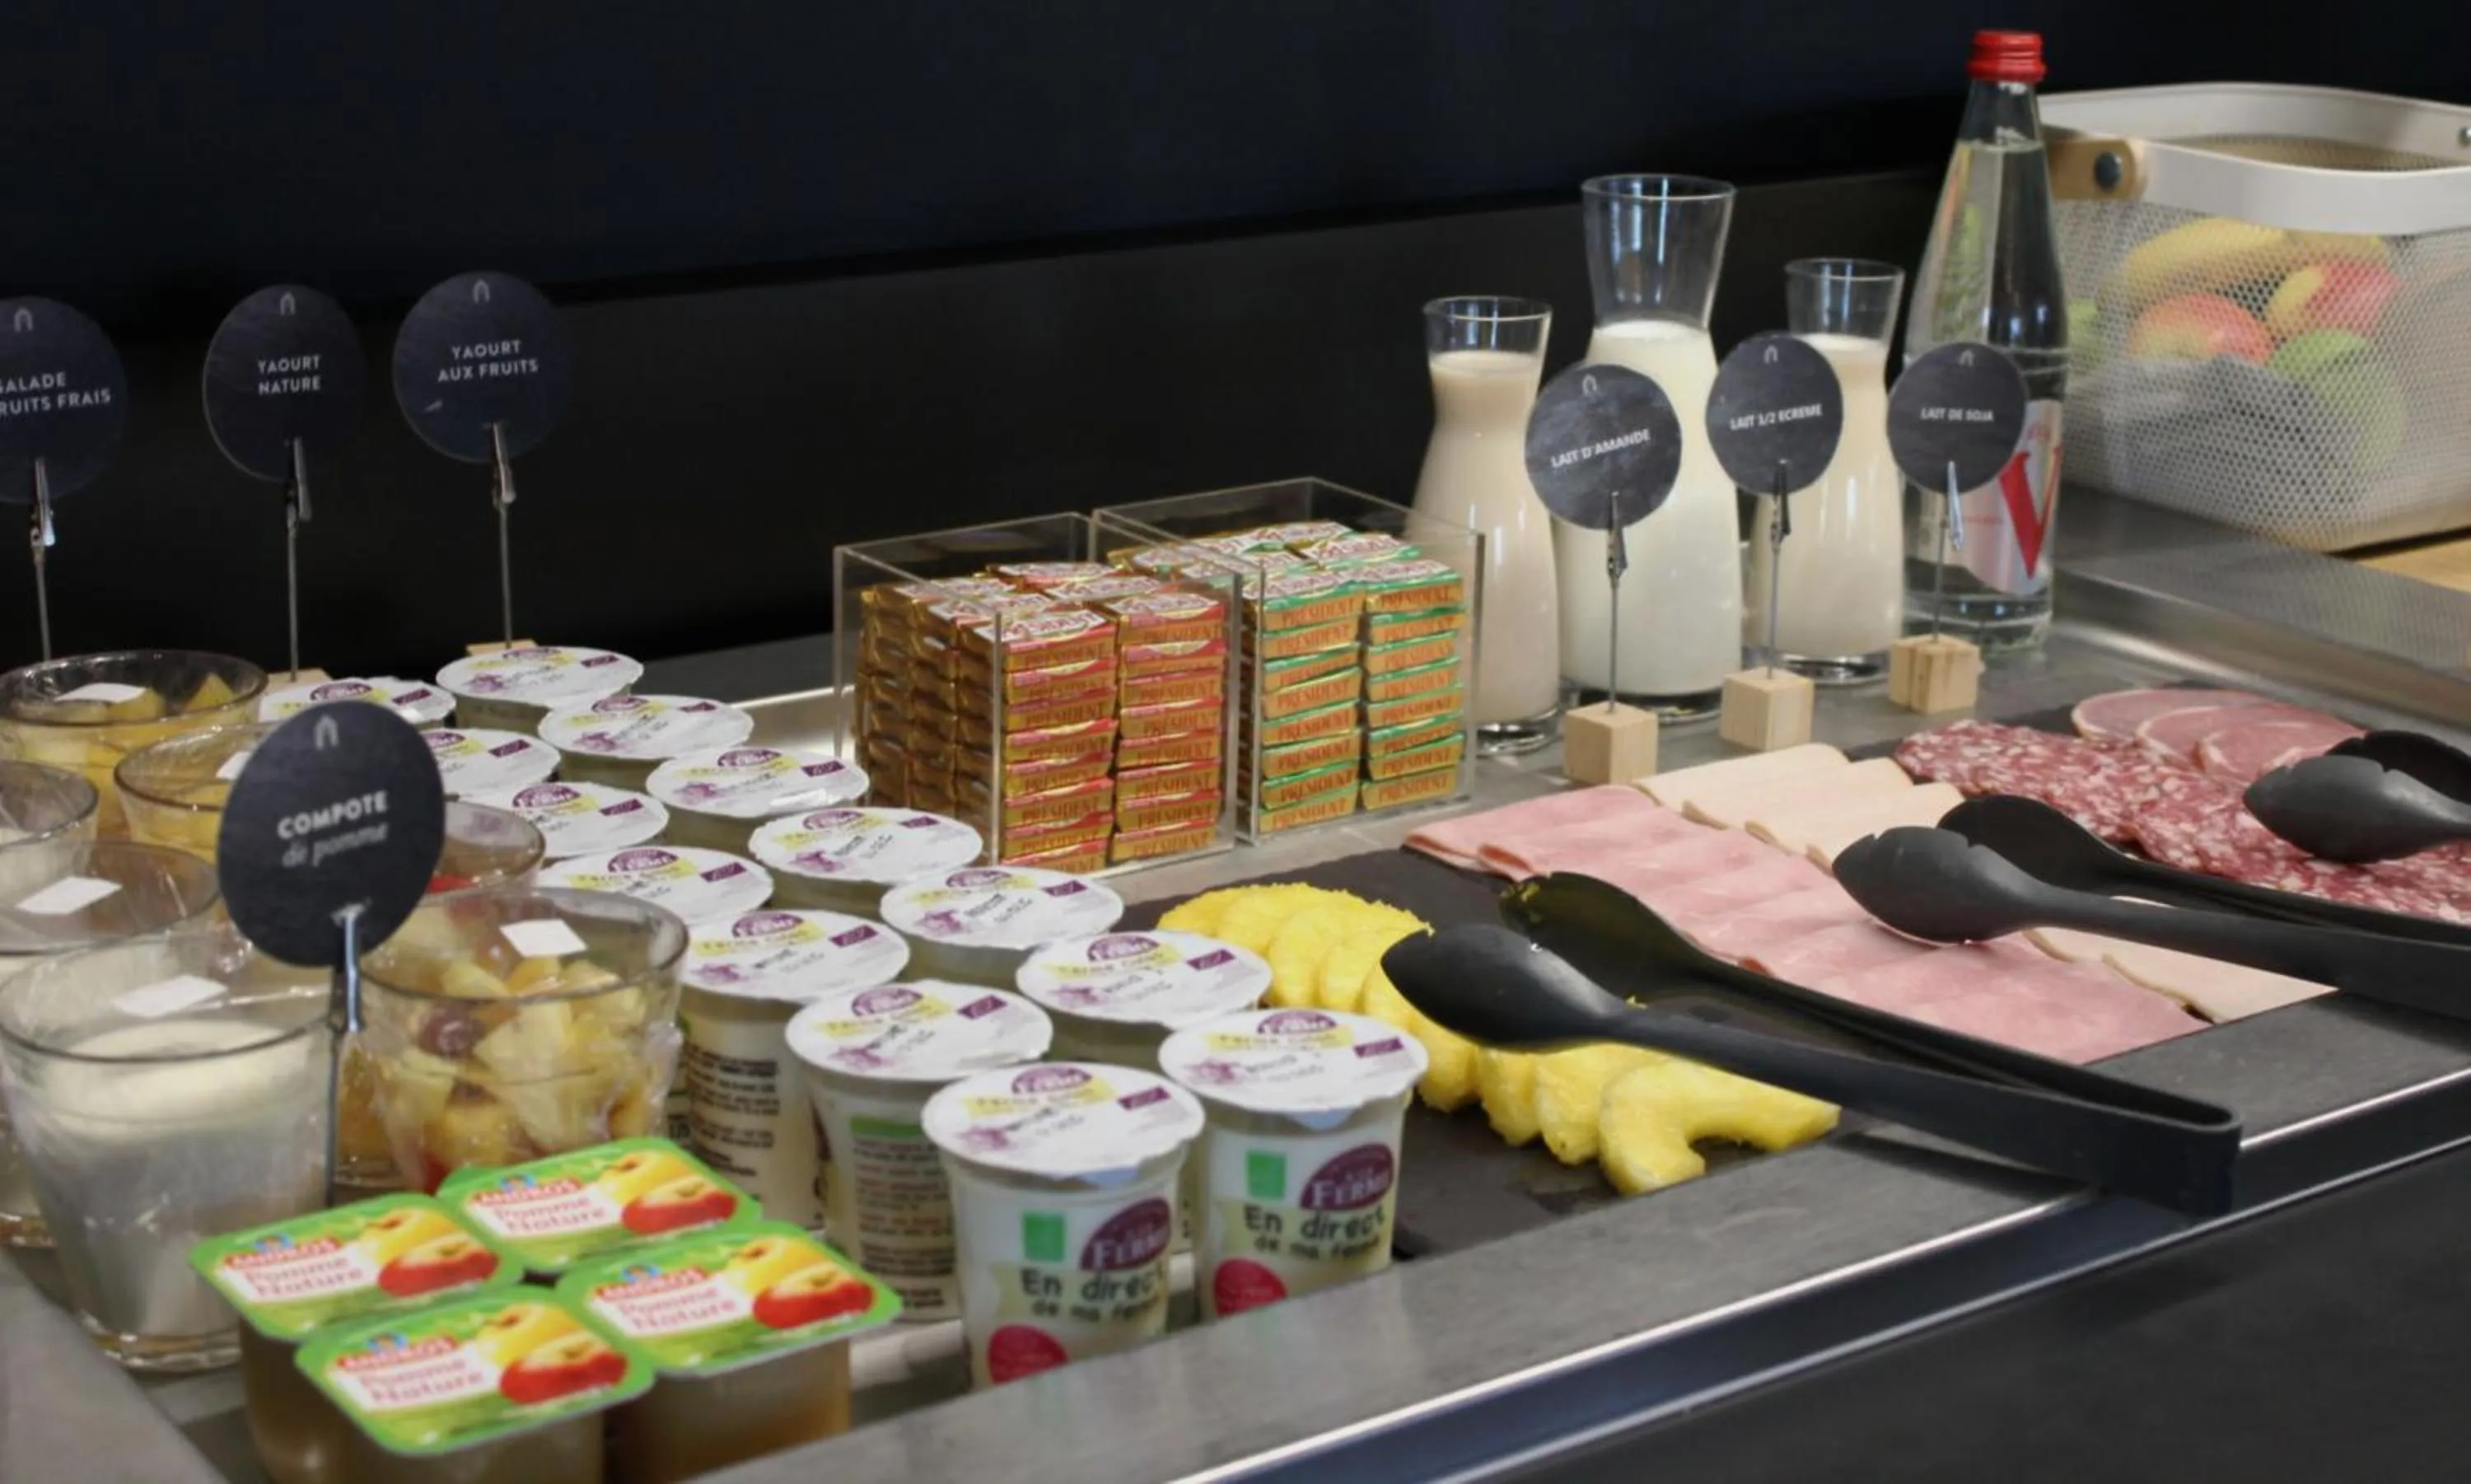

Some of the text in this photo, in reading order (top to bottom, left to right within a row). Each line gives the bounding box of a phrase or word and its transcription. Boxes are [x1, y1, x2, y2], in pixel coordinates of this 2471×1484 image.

[451, 338, 523, 360] YAOURT
[257, 353, 321, 376] YAOURT
[437, 357, 538, 383] AUX FRUITS
[258, 375, 321, 396] NATURE
[58, 388, 110, 408] FRAIS
[1730, 414, 1754, 431] LAIT
[1758, 410, 1776, 427] 1/2
[1921, 407, 1946, 421] LAIT
[1949, 408, 1963, 422] DE
[1551, 450, 1579, 469] LAIT
[277, 790, 390, 840] COMPOTE
[282, 822, 390, 868] de pomme
[1244, 1203, 1385, 1240] En direct
[1021, 1266, 1063, 1297] En
